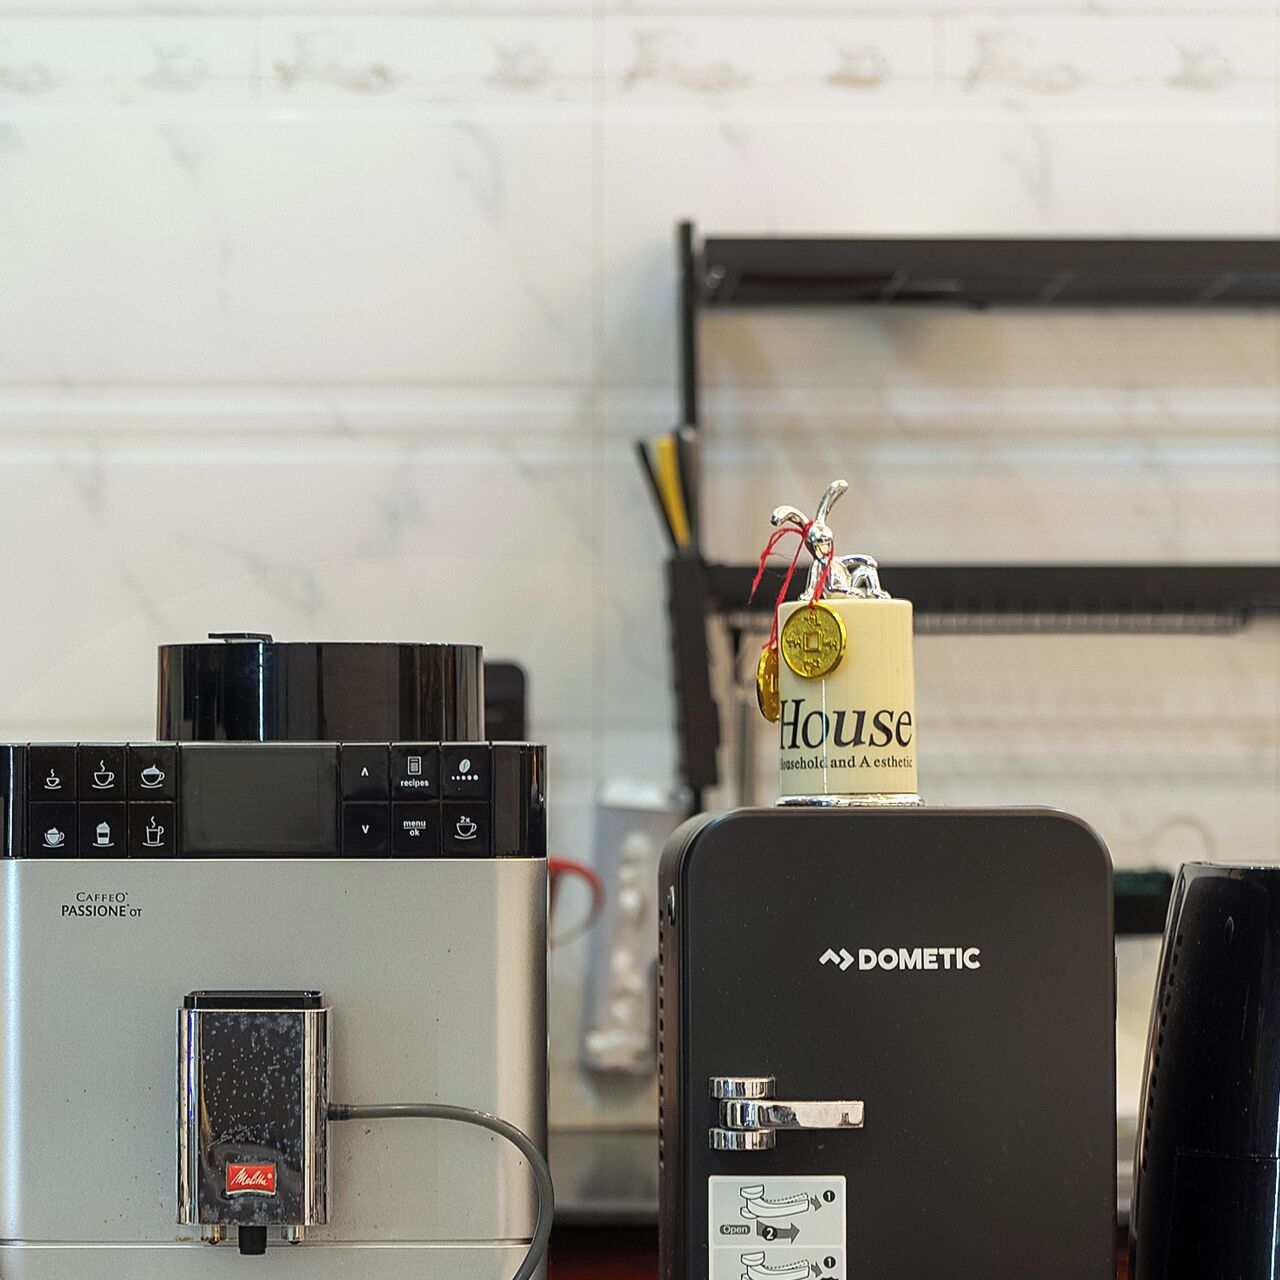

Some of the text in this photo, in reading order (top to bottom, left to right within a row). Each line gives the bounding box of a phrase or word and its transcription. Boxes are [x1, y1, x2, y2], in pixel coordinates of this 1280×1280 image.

[780, 698, 913, 750] House
[830, 755, 856, 769] and
[400, 779, 430, 789] recipes
[403, 820, 427, 828] menu
[460, 815, 471, 824] 2x
[409, 828, 421, 837] ok
[61, 904, 127, 917] PASSIONE
[858, 947, 981, 971] DOMETIC
[722, 1225, 748, 1236] Open
